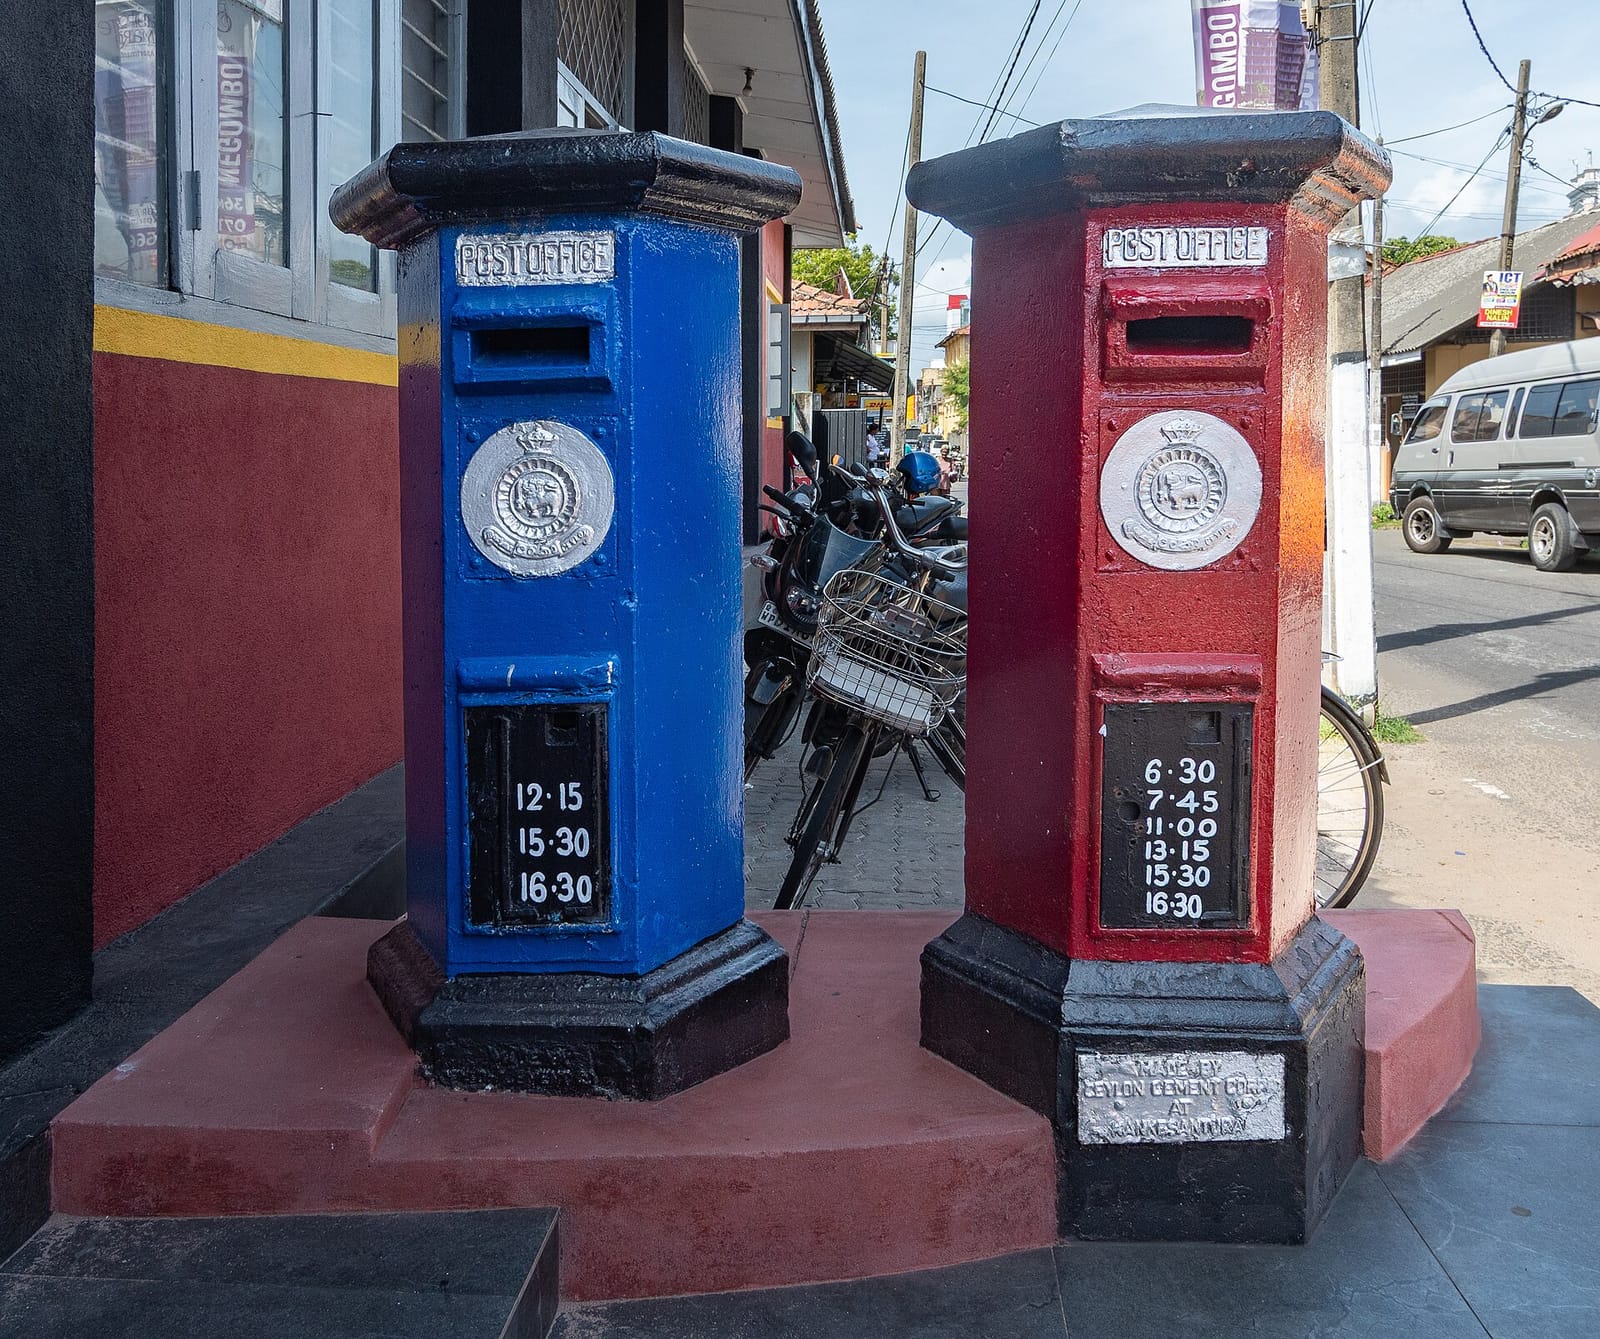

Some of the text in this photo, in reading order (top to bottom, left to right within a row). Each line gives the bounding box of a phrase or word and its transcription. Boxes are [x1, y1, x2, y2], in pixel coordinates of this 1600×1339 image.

[1106, 227, 1261, 262] POST OFFICE
[460, 240, 610, 277] POST OFFICE
[1499, 272, 1522, 283] ICT
[1198, 1059, 1222, 1076] BY
[1083, 1080, 1145, 1098] CEYLON
[1150, 1078, 1221, 1097] CEMENT
[1167, 1098, 1194, 1117] AT
